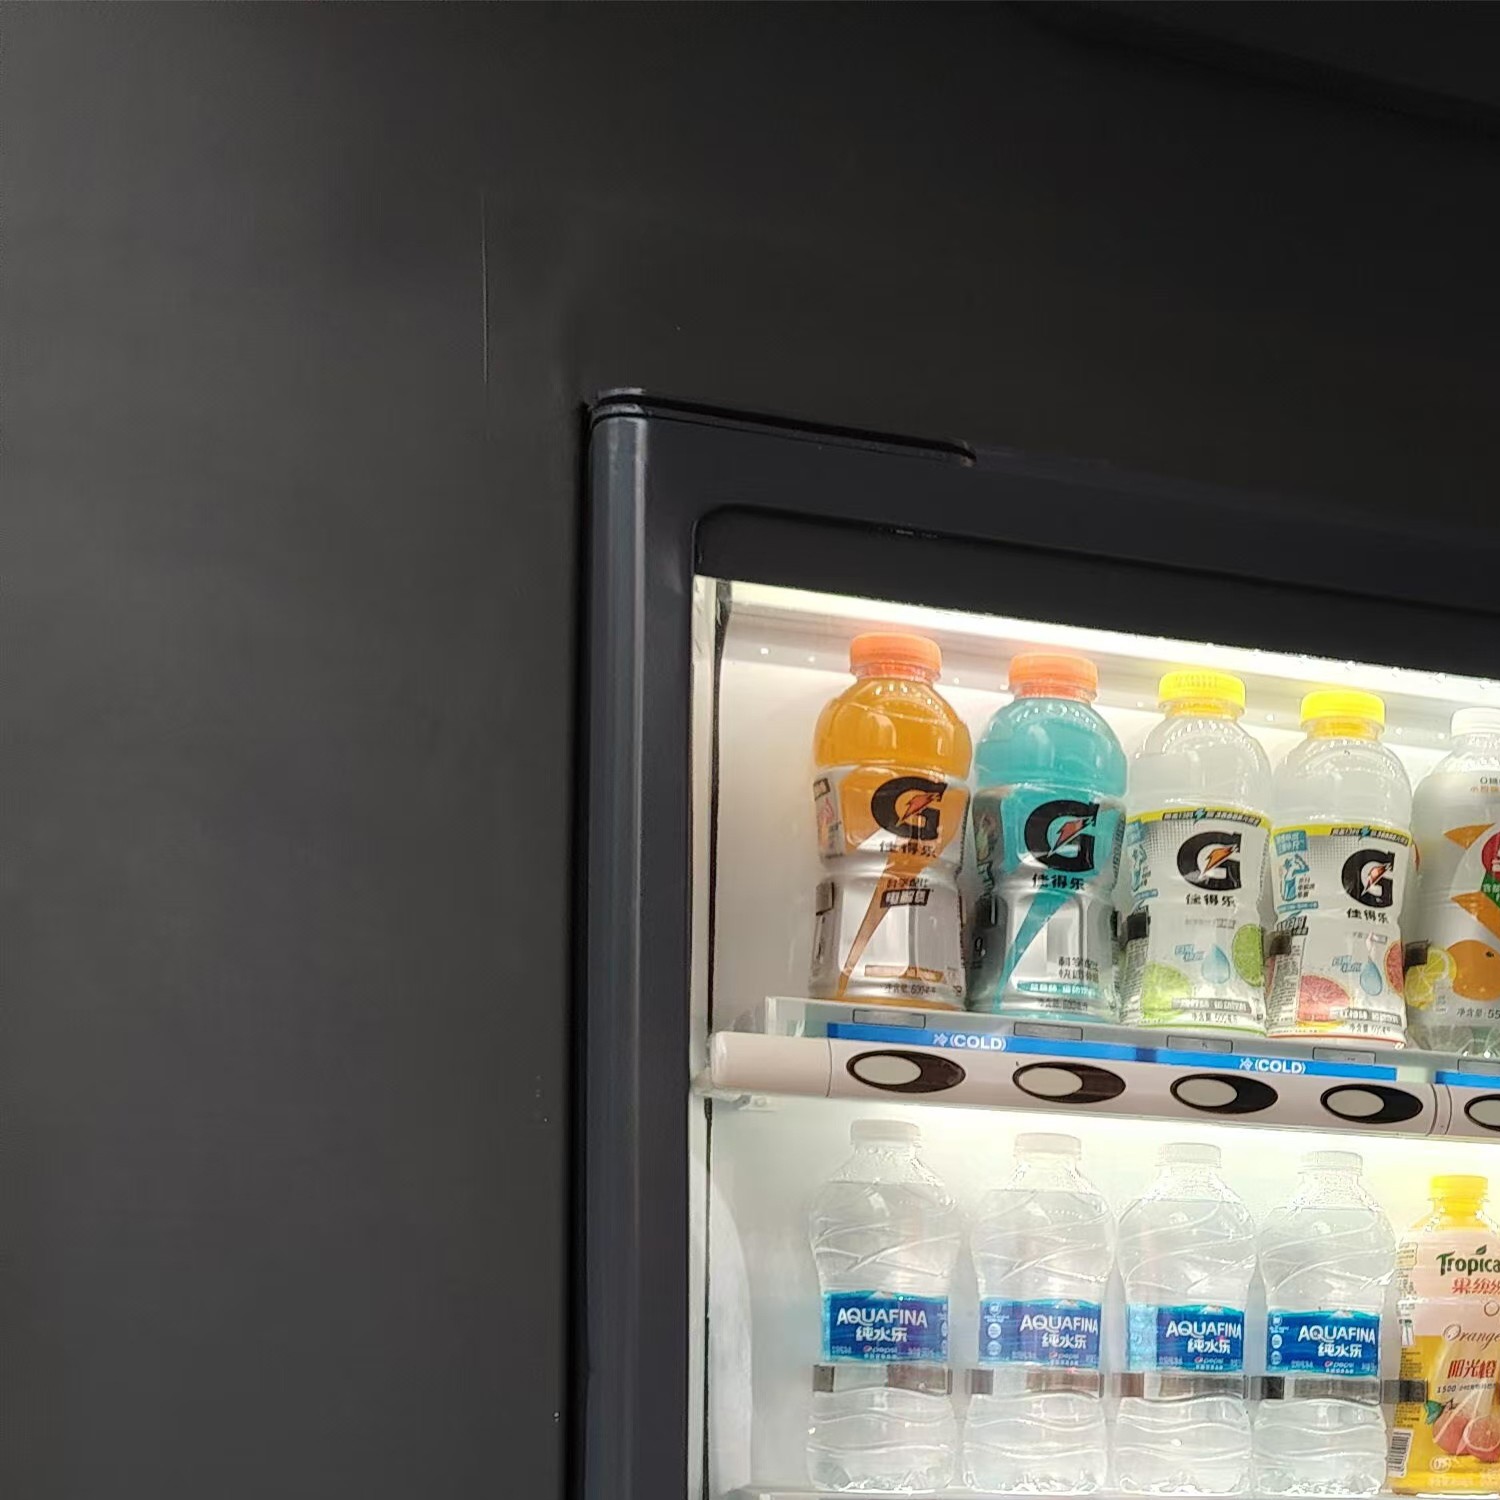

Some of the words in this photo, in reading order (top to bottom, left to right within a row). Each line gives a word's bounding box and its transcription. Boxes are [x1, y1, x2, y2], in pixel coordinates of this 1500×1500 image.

[870, 776, 948, 840] G
[1024, 799, 1100, 873] G
[1176, 831, 1242, 891] G
[1031, 872, 1086, 892] 佳得乐
[1341, 848, 1395, 908] G
[1186, 893, 1236, 908] 佳得乐
[1346, 908, 1389, 924] 佳得乐
[837, 1308, 928, 1329] AQUAFINA
[1020, 1314, 1099, 1334] AQUAFINA
[855, 1326, 907, 1343] 纯水乐
[1166, 1320, 1242, 1338] AQUAFINA
[1298, 1324, 1376, 1344] AQUAFINA
[1041, 1333, 1088, 1350] 纯水乐
[1187, 1338, 1231, 1355] 纯水乐
[1317, 1342, 1362, 1358] 纯水乐
